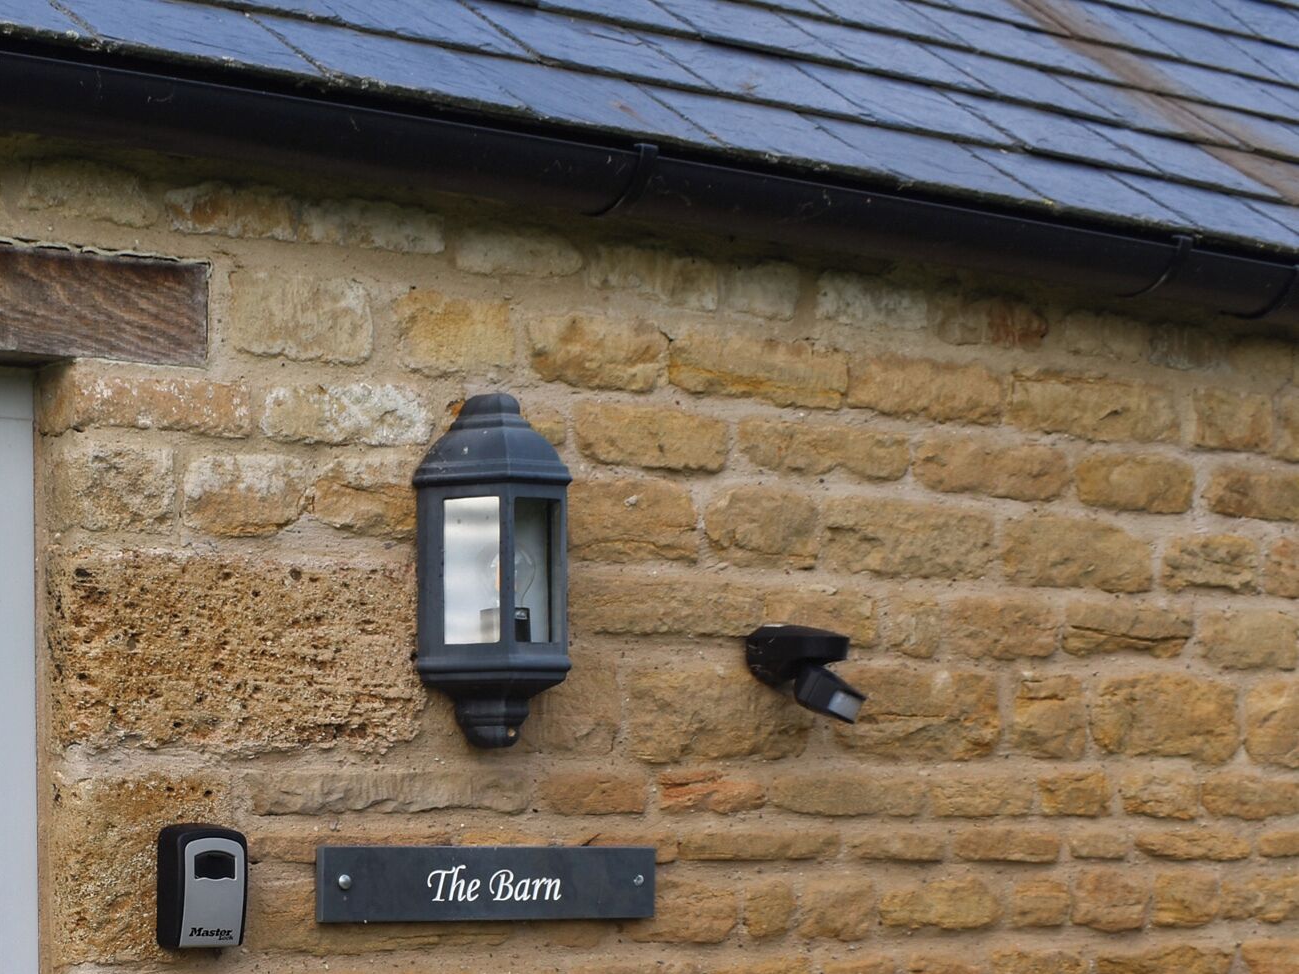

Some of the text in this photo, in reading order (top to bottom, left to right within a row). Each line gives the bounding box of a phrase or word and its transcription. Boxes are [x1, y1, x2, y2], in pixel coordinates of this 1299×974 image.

[427, 864, 562, 902] The Barn
[189, 927, 233, 937] Master
